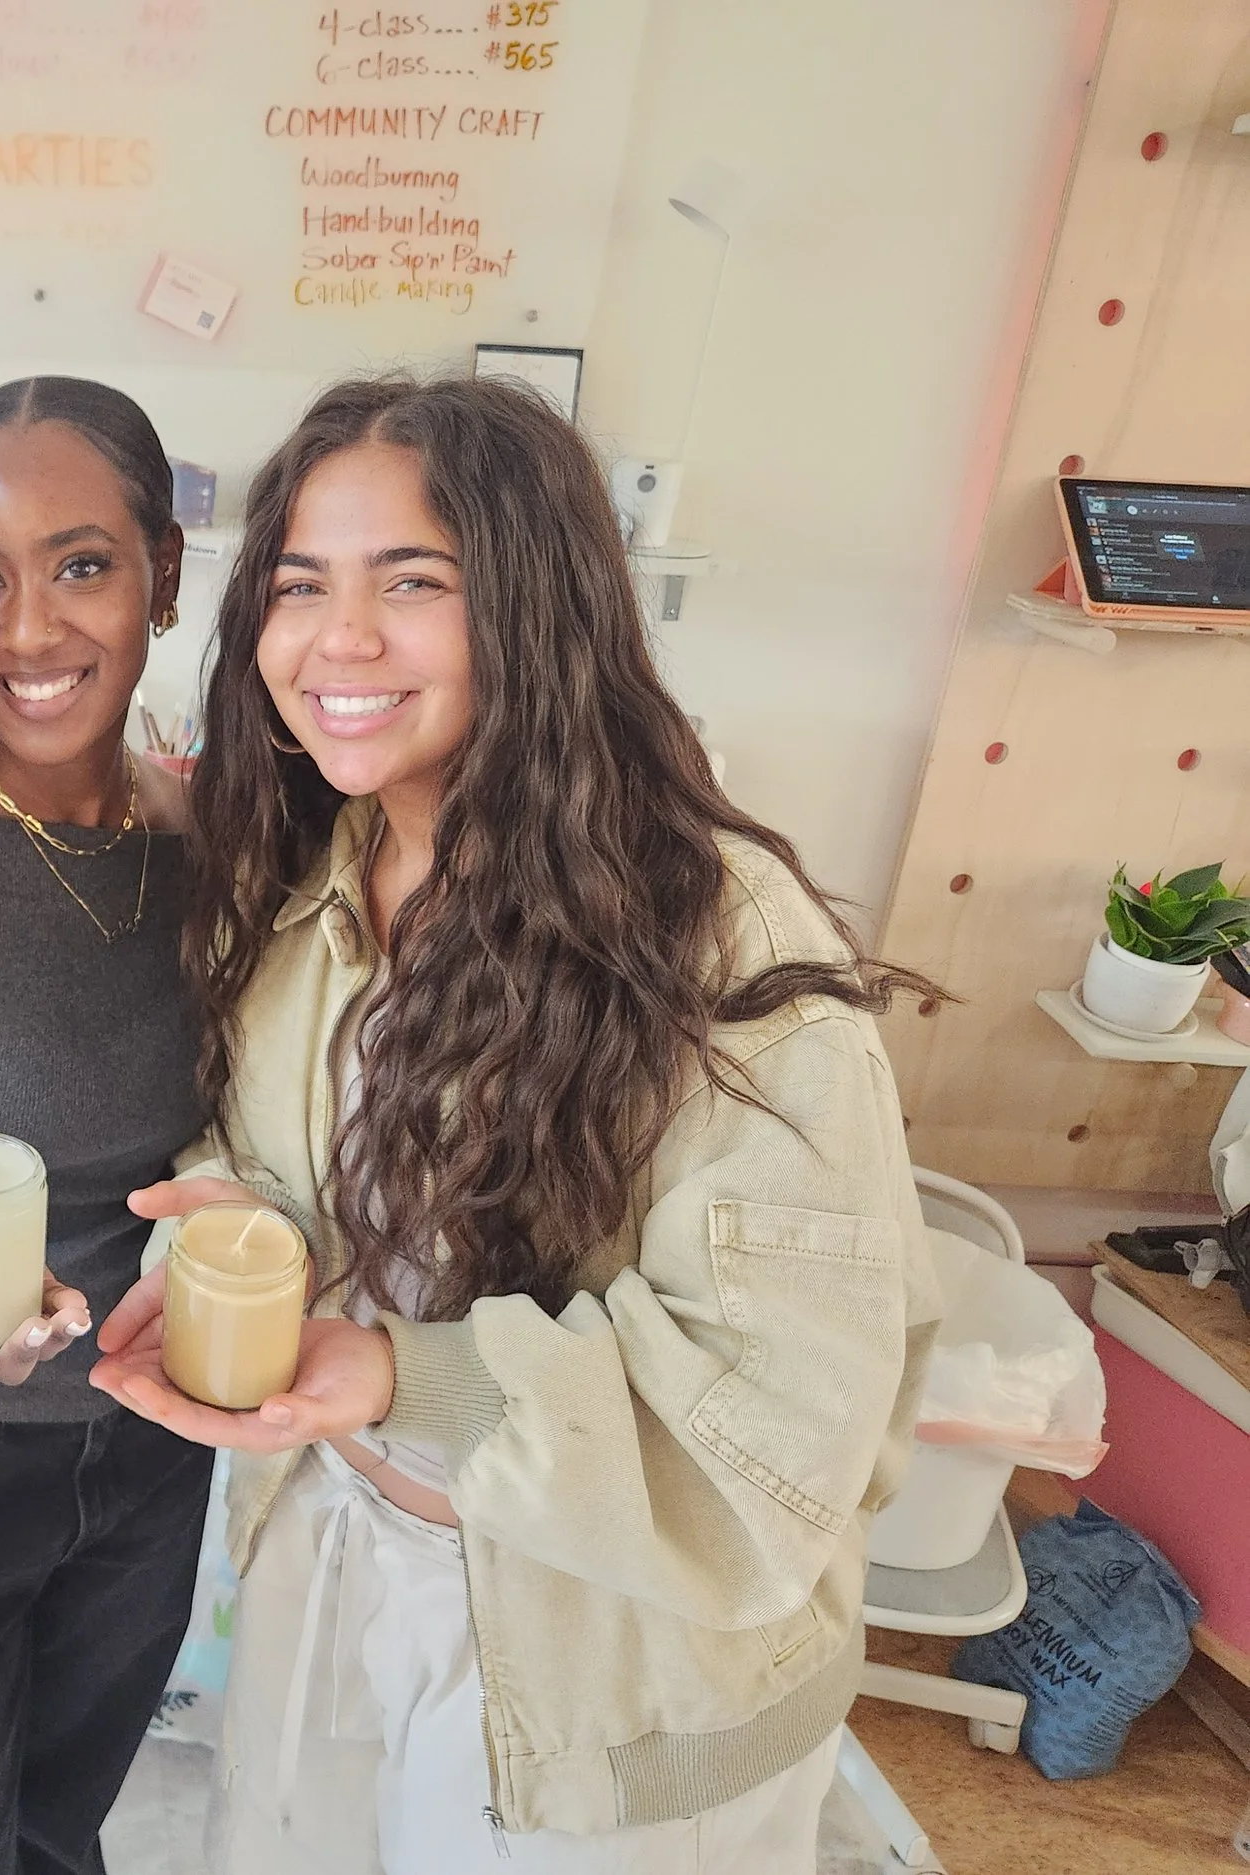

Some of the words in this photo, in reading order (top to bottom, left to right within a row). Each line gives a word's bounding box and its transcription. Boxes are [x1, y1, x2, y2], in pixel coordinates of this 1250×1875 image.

[265, 104, 447, 141] COMMUNITY
[457, 106, 546, 140] CRAFT
[300, 156, 459, 202] Woodburning
[301, 245, 377, 273] Sober
[453, 244, 517, 278] Paint
[294, 276, 382, 307] Candle
[1022, 1608, 1103, 1690] LENNIUM
[1029, 1647, 1073, 1690] WAX
